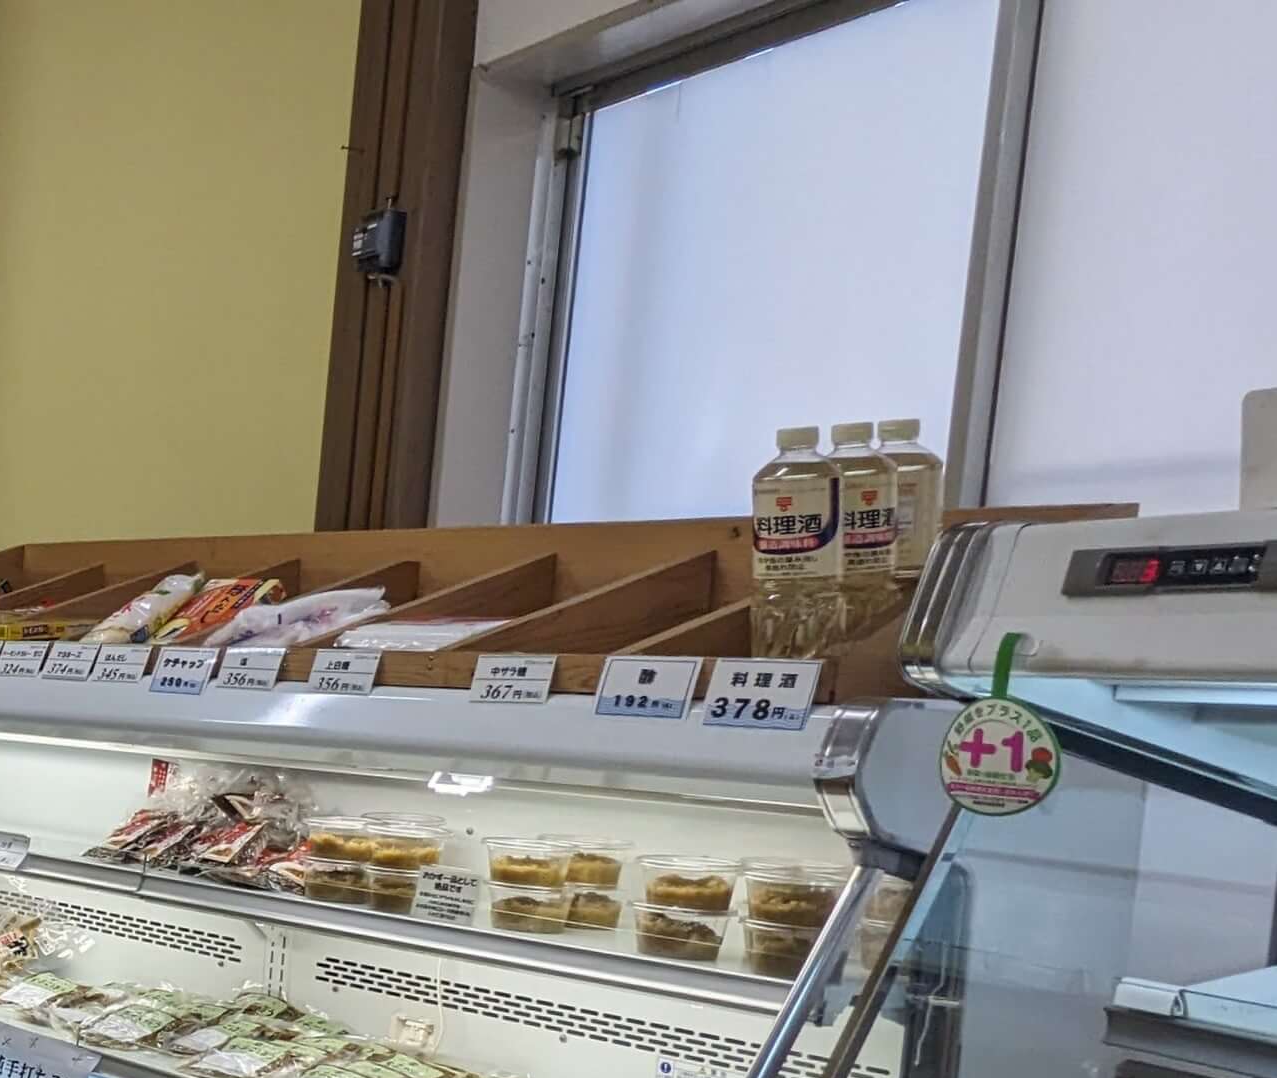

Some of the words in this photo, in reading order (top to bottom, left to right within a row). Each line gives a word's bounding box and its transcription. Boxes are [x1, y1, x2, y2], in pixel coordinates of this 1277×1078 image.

[757, 513, 822, 535] 料理酒
[163, 658, 204, 669] ケチャップ
[490, 666, 527, 678] 中ザラ糖
[730, 671, 799, 690] 料理酒
